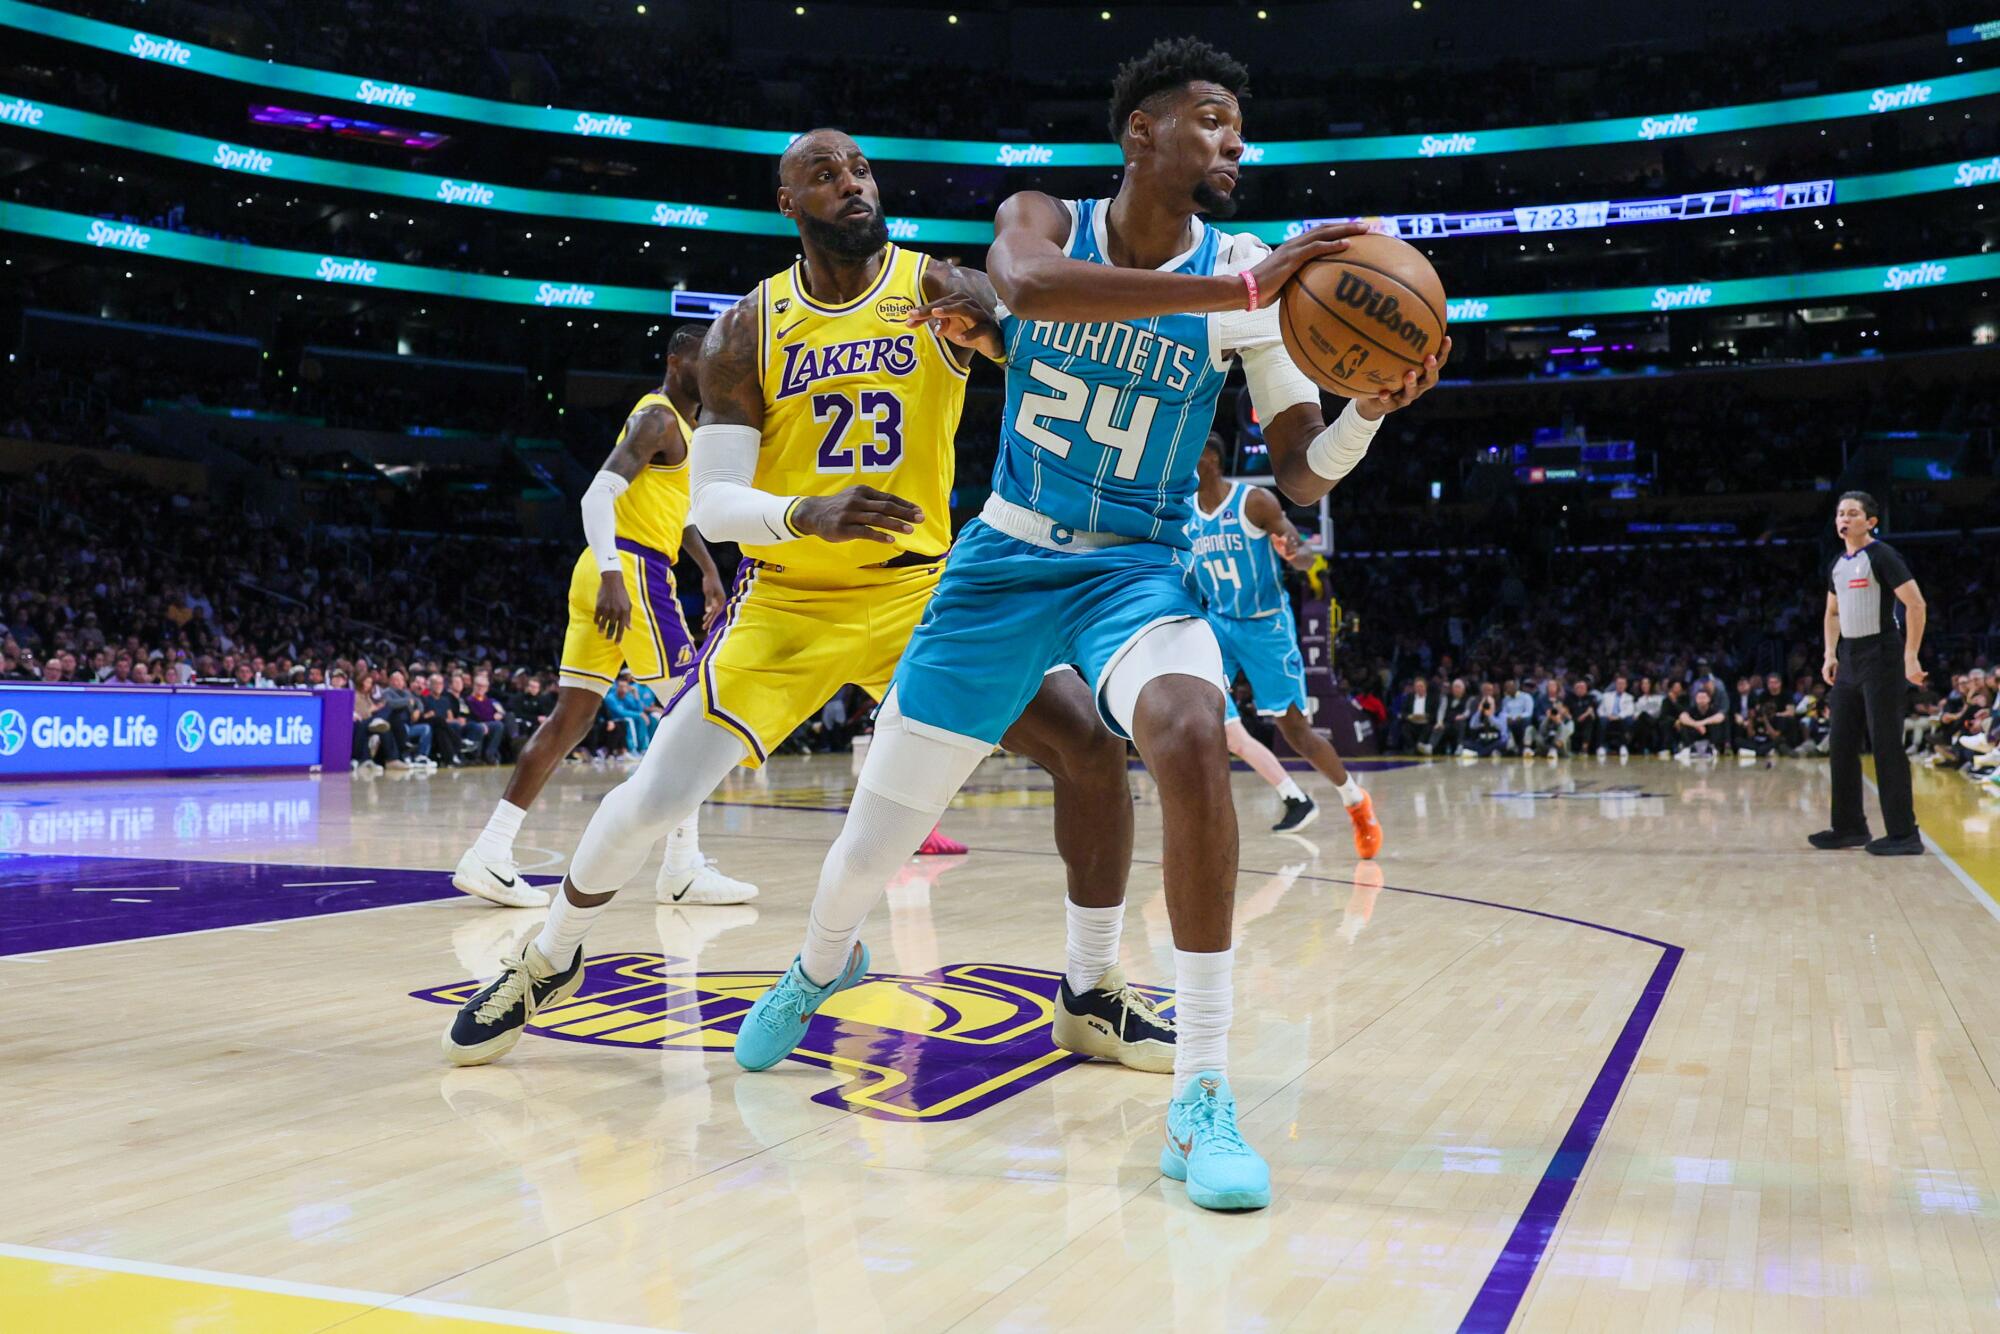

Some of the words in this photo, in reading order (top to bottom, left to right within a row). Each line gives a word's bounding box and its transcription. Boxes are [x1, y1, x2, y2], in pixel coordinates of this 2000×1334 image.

[129, 33, 191, 65] Sprite
[356, 80, 416, 107] Sprite
[1869, 84, 1933, 113] Sprite
[0, 99, 43, 125] rite
[574, 113, 632, 138] Sprite
[1638, 114, 1698, 140] Sprite
[213, 144, 273, 173] Sprite
[997, 144, 1053, 167] Sprite
[1418, 133, 1476, 158] Sprite
[1954, 157, 2000, 187] Spri
[437, 179, 494, 205] Sprite
[651, 203, 708, 227] Sprite
[1408, 215, 1434, 236] 19
[1460, 217, 1504, 230] Lakers
[1527, 207, 1578, 230] 7:23
[1618, 204, 1672, 219] Hornets
[1702, 196, 1717, 215] 7
[86, 221, 150, 250] Sprite
[316, 257, 377, 283] Sprite
[1883, 262, 1947, 291] Sprite
[535, 283, 594, 307] Sprite
[879, 302, 913, 315] bibigo
[1447, 299, 1488, 320] prite
[1651, 285, 1712, 311] Sprite
[1335, 269, 1430, 353] Wilson
[775, 334, 918, 400] LAKERS
[1031, 320, 1196, 392] HORNETS
[812, 391, 904, 474] 23
[1013, 358, 1161, 481] 24
[1202, 556, 1243, 591] 14
[31, 715, 109, 749] Globe
[113, 714, 158, 748] Life
[208, 716, 272, 746] Globe
[275, 715, 313, 745] Life
